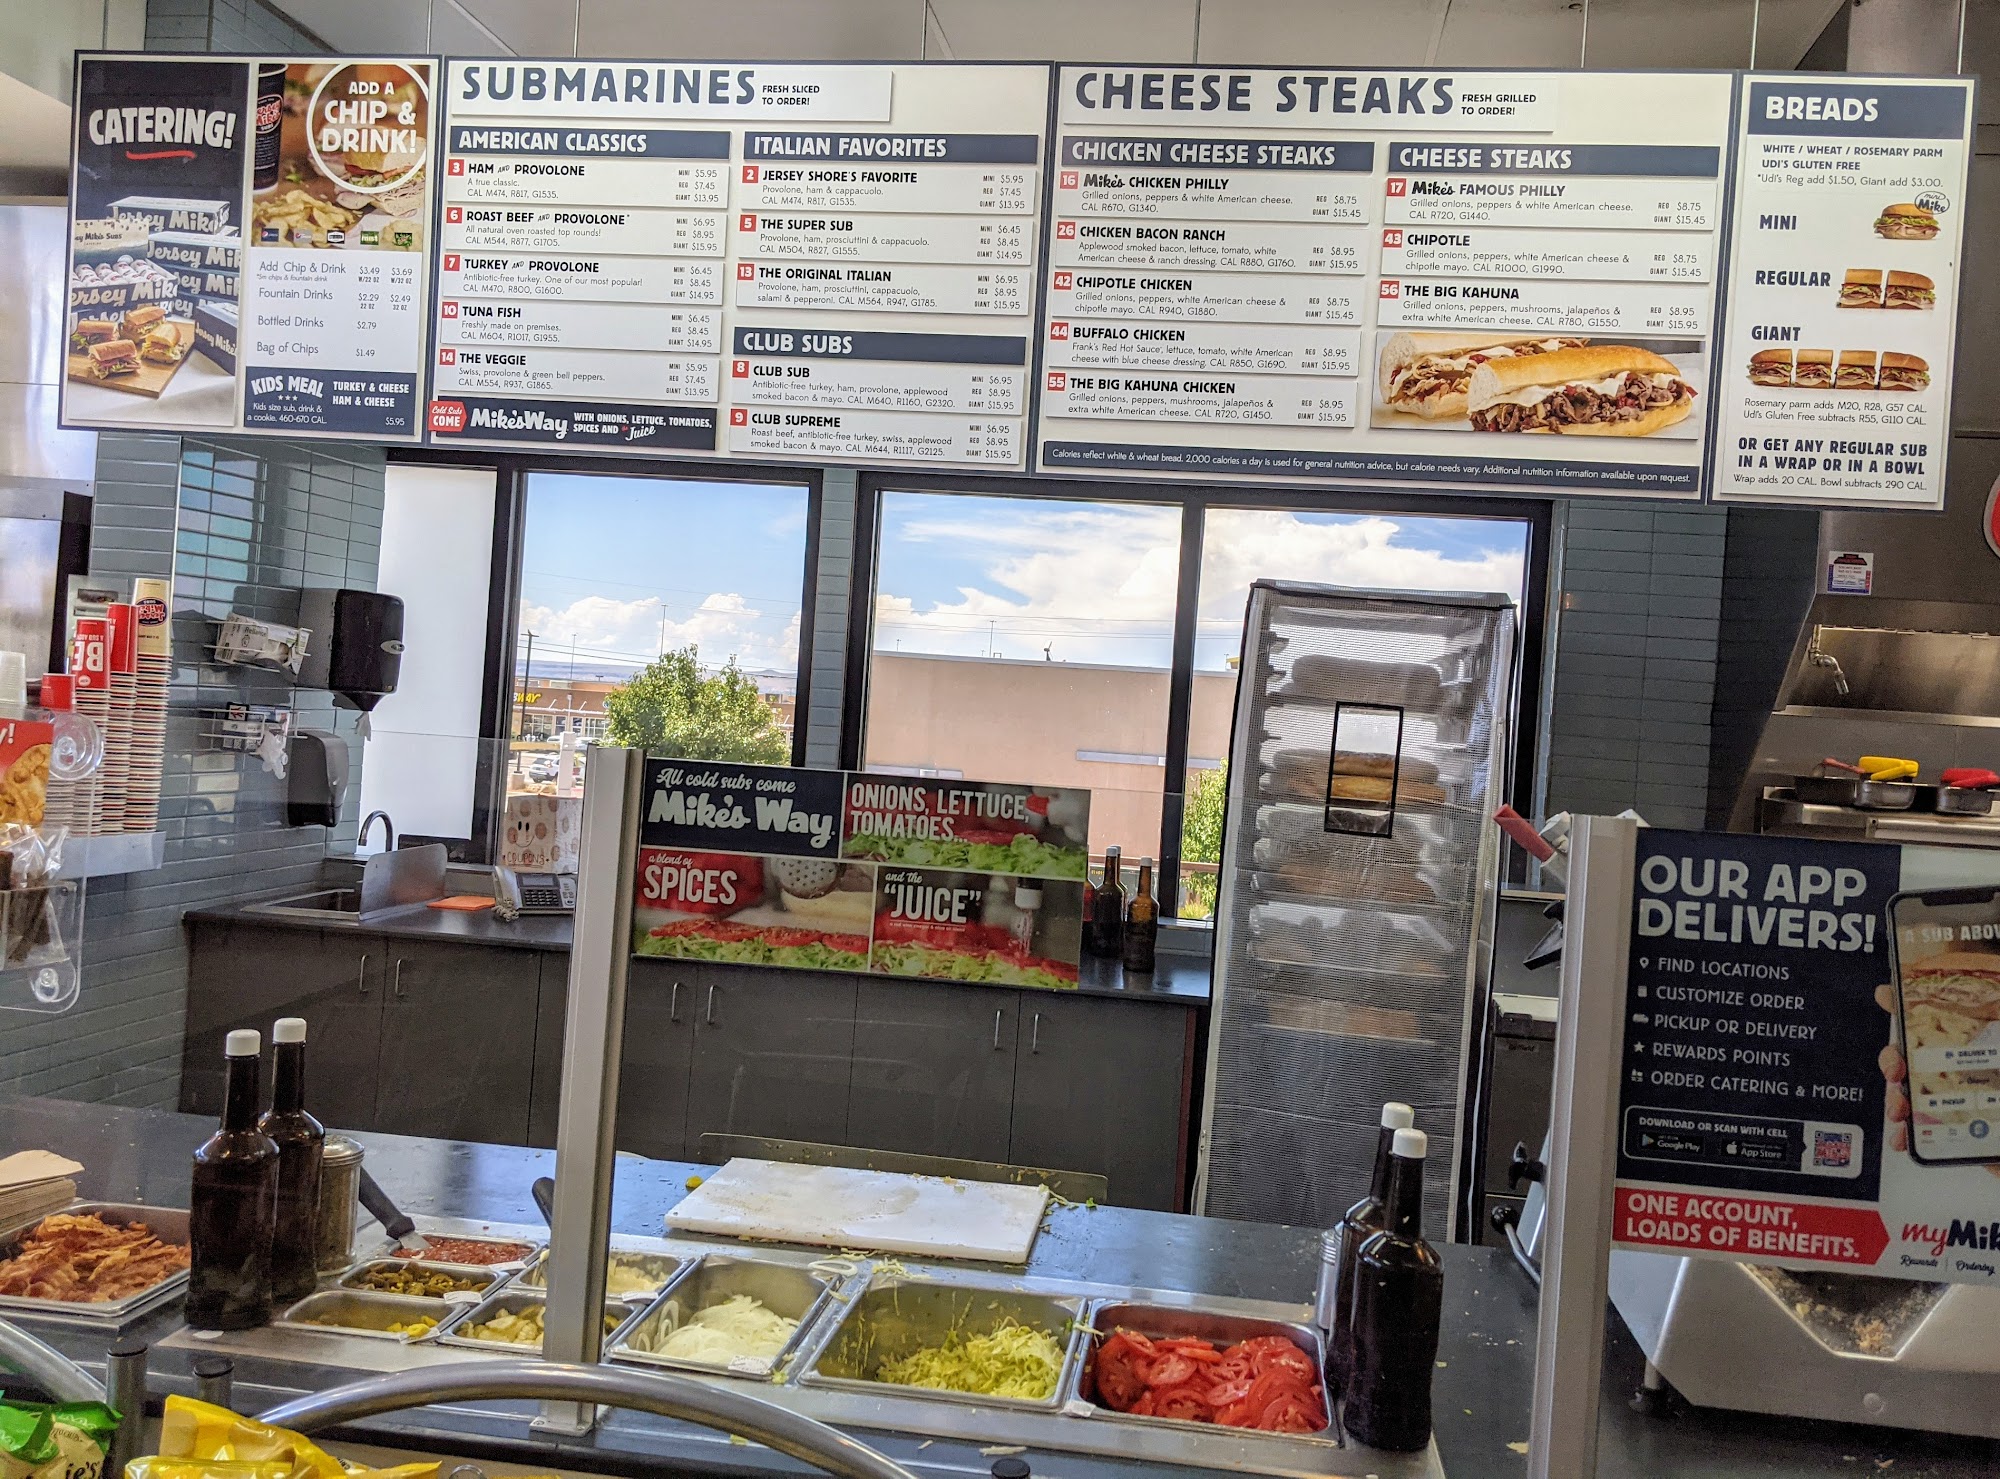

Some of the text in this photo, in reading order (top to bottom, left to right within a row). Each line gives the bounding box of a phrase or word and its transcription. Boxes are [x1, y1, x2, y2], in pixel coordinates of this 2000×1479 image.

[348, 81, 395, 97] ADD A
[462, 67, 756, 105] SUBMARINES
[762, 85, 820, 93] FRESH SLICED
[1075, 73, 1453, 114] CHEESE STEAKS
[761, 97, 810, 105] TO ORDER!
[1462, 94, 1537, 103] FRESH GRILLED
[324, 100, 416, 125] CHIP &
[1765, 96, 1878, 121] BREADS
[88, 107, 237, 149] CATERING!
[321, 128, 417, 154] DRINK!
[458, 131, 647, 152] AMERICAN CLASSICS
[754, 137, 947, 157] ITALIAN FAVORITES
[1070, 142, 1336, 165] CHICKEN CHEESE STEAKS
[1399, 148, 1572, 169] CHEESE STEAKS
[452, 163, 461, 173] 3
[468, 163, 494, 174] HAM
[514, 164, 585, 176] PROVOLONE
[694, 169, 718, 178] $5.95
[762, 170, 918, 183] JERSEY SHORE'S FAVORITE
[1063, 175, 1076, 187] 16
[1083, 174, 1230, 190] Mike's CHICKEN PHILLY
[467, 188, 559, 199] CAL M474, R817, G1535.
[694, 181, 716, 190] $7.45
[1411, 181, 1566, 196] Mike's FAMOUS PHILLY
[693, 193, 719, 202] $13.95
[1759, 214, 1797, 230] MINI
[1080, 226, 1226, 241] CHICKEN BACON RANCH
[259, 261, 347, 274] Add Chip & Drink
[359, 266, 381, 275] $3.49
[391, 267, 413, 276] $3.69
[758, 267, 892, 282] THE ORIGINAL ITALIAN
[1755, 270, 1831, 286] REGULAR
[1404, 285, 1520, 299] THE BIG KAHUNA
[462, 306, 521, 318] TUNA FISH
[1751, 326, 1801, 341] GIANT
[743, 333, 853, 354] CLUB SUBS
[459, 353, 526, 365] THE VEGGIE
[753, 366, 810, 378] CLUB SUB
[251, 377, 324, 398] KIDS MEAL
[333, 381, 409, 393] TURKEY & CHEESE
[1070, 378, 1236, 394] THE BIG KAHUNA CHICKEN
[573, 412, 712, 428] WITH ONIONS, LETTUCE, TOMATOES,
[751, 414, 841, 427] CLUB SUPREME
[572, 423, 619, 434] SPICES AND
[626, 427, 656, 440] Juice
[1738, 437, 1928, 457] OR GET ANY REGULAR SUB
[656, 768, 796, 793] All cold subs come
[648, 790, 751, 829] Mike's
[851, 783, 1032, 822] ONIONS, LETTUCE,
[851, 811, 969, 843] TOMATOES...
[507, 851, 545, 866] COUPONS
[648, 853, 694, 869] a blend of
[643, 866, 738, 905] SPICES
[883, 872, 924, 884] and the
[1640, 855, 1867, 906] OUR APP
[1637, 898, 1877, 953] DELIVERS!
[1658, 957, 1790, 980] FIND LOCATIONS
[1656, 986, 1805, 1010] CUSTOMIZE ORDER
[1655, 1014, 1817, 1039] PICKUP OR DELIVERY
[1652, 1042, 1791, 1066] REWARDS POINTS
[1650, 1071, 1864, 1101] ORDER CATERING & MORE!
[1638, 1117, 1788, 1138] DOWNLOAD OR SCAN WITH CELL
[1657, 1140, 1701, 1152] Google Play
[1740, 1148, 1782, 1158] App Store
[1628, 1193, 1799, 1229] ONE ACCOUNT,
[1626, 1218, 1860, 1257] LOADS OF BENEFITS.
